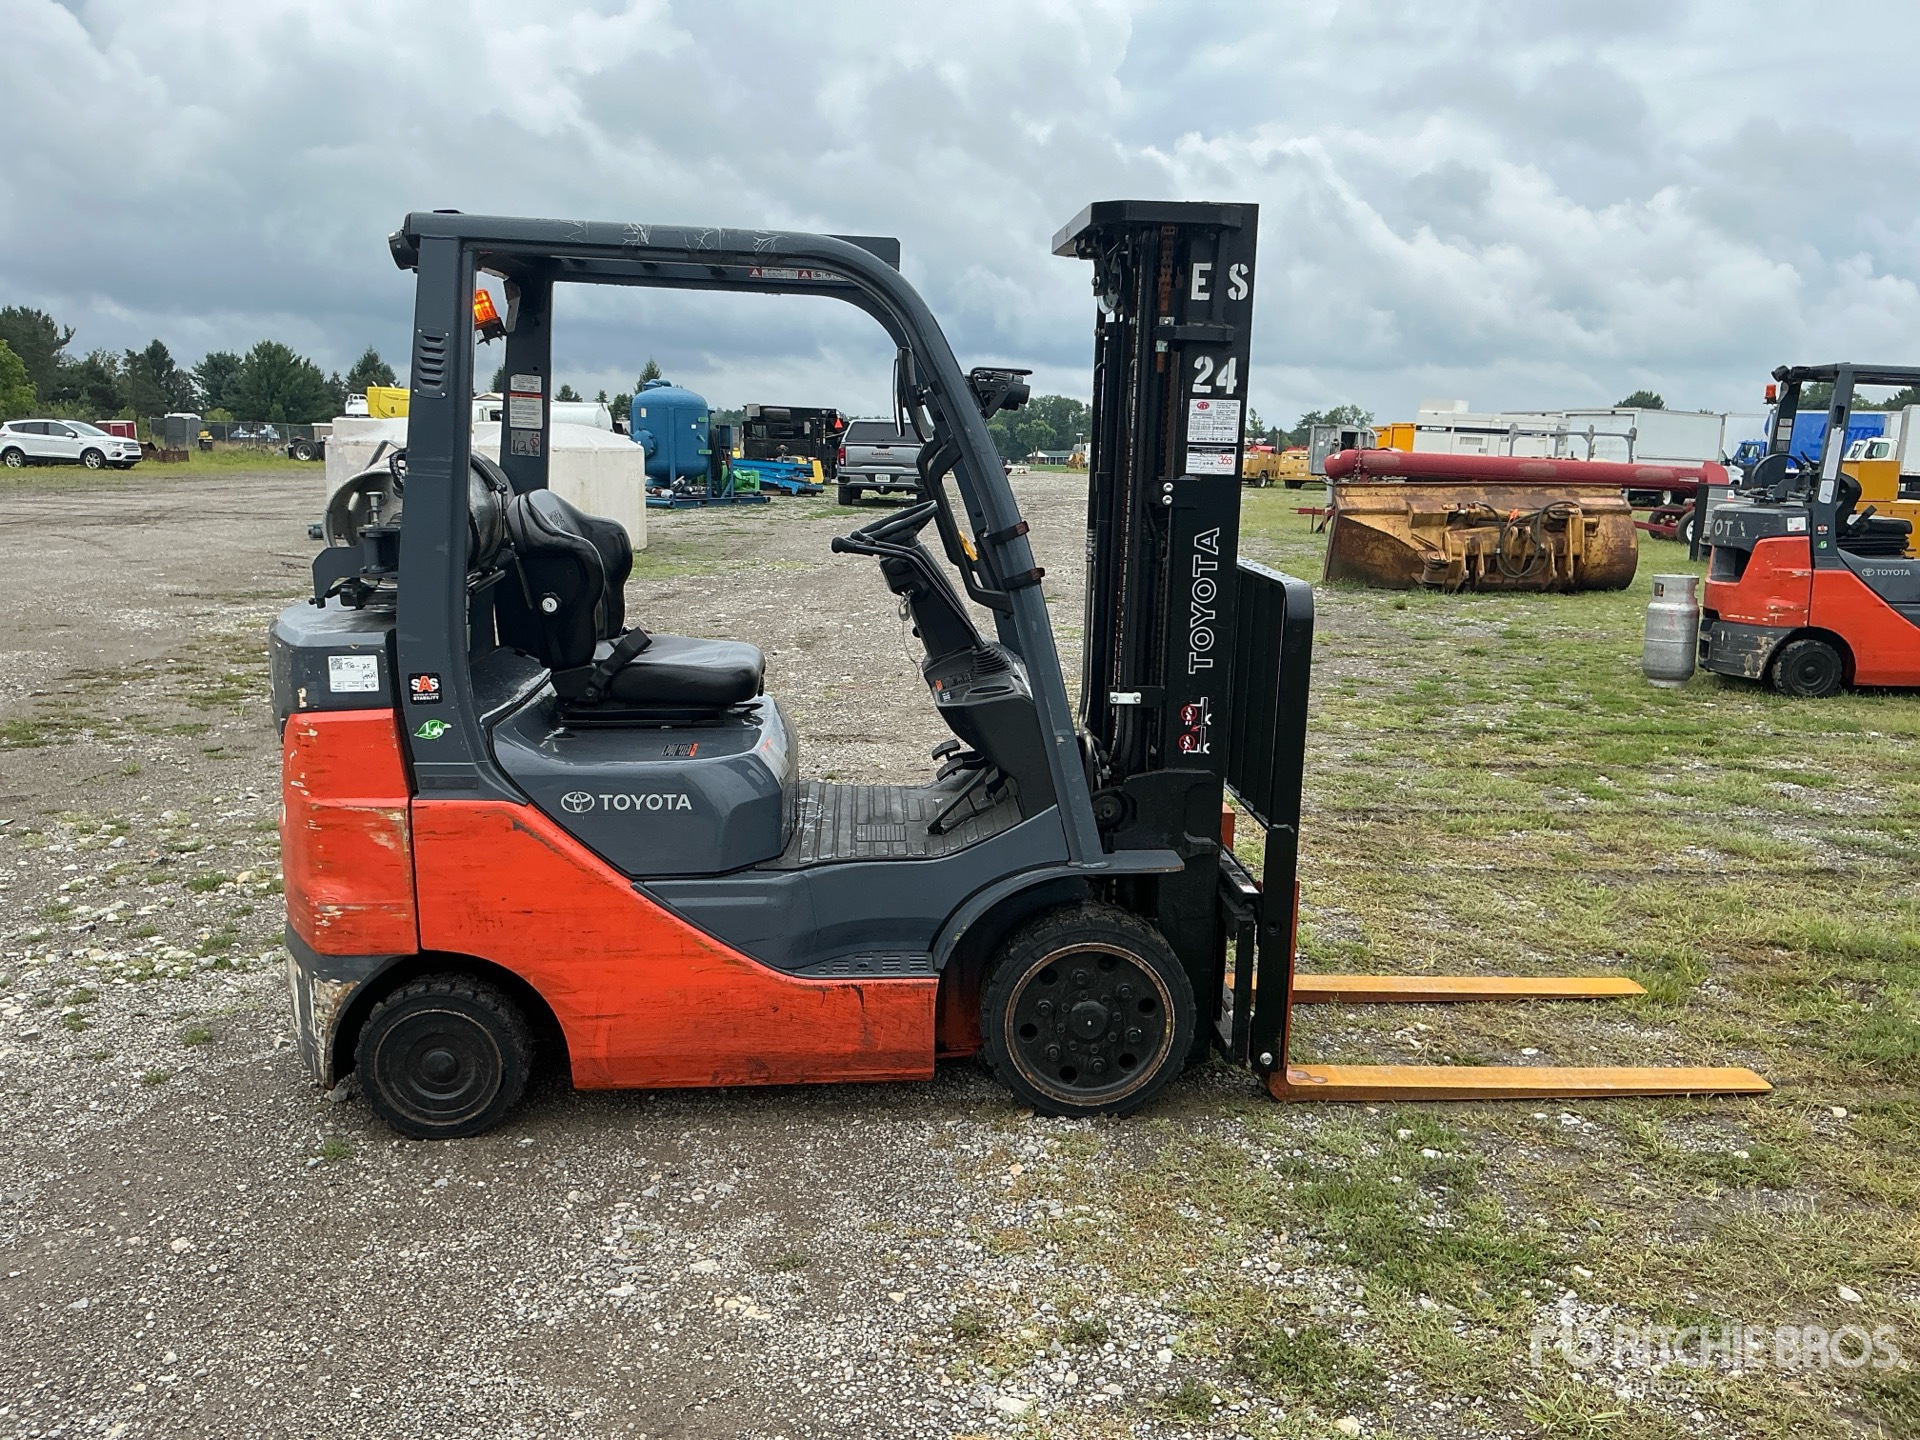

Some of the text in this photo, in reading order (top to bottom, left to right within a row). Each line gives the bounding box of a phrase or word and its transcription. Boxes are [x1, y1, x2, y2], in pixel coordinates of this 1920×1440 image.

[1190, 262, 1249, 301] E S
[1192, 355, 1238, 395] 24
[1876, 568, 1911, 576] TOYOTA
[1187, 527, 1220, 674] TOYOTA
[410, 675, 440, 692] SAS
[598, 793, 693, 811] TOYOTA
